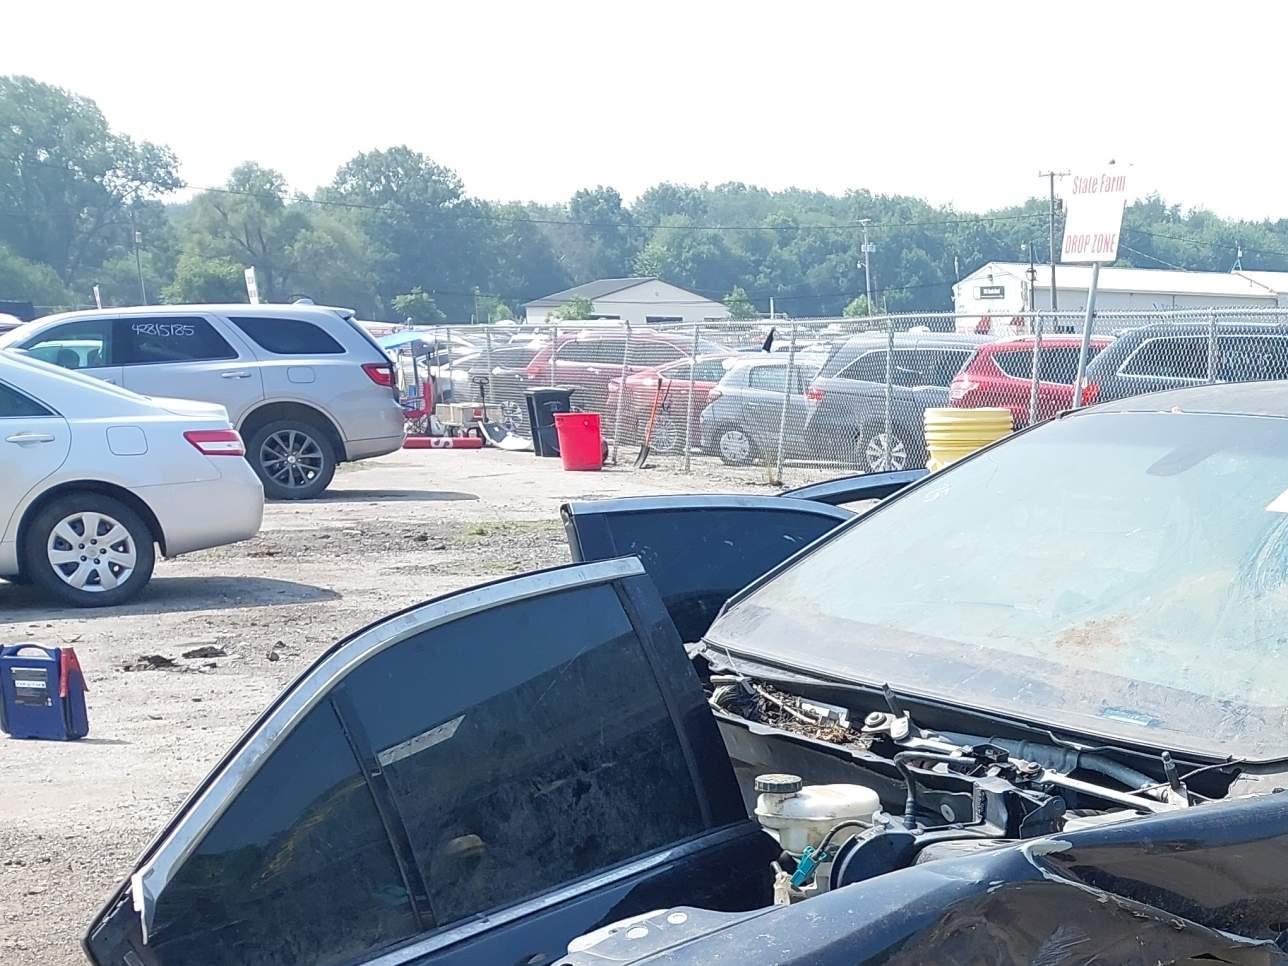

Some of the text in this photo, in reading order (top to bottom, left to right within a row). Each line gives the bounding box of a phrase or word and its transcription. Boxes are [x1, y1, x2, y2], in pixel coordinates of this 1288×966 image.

[1072, 173, 1126, 195] State Farm
[1065, 233, 1116, 254] DROP ZONE
